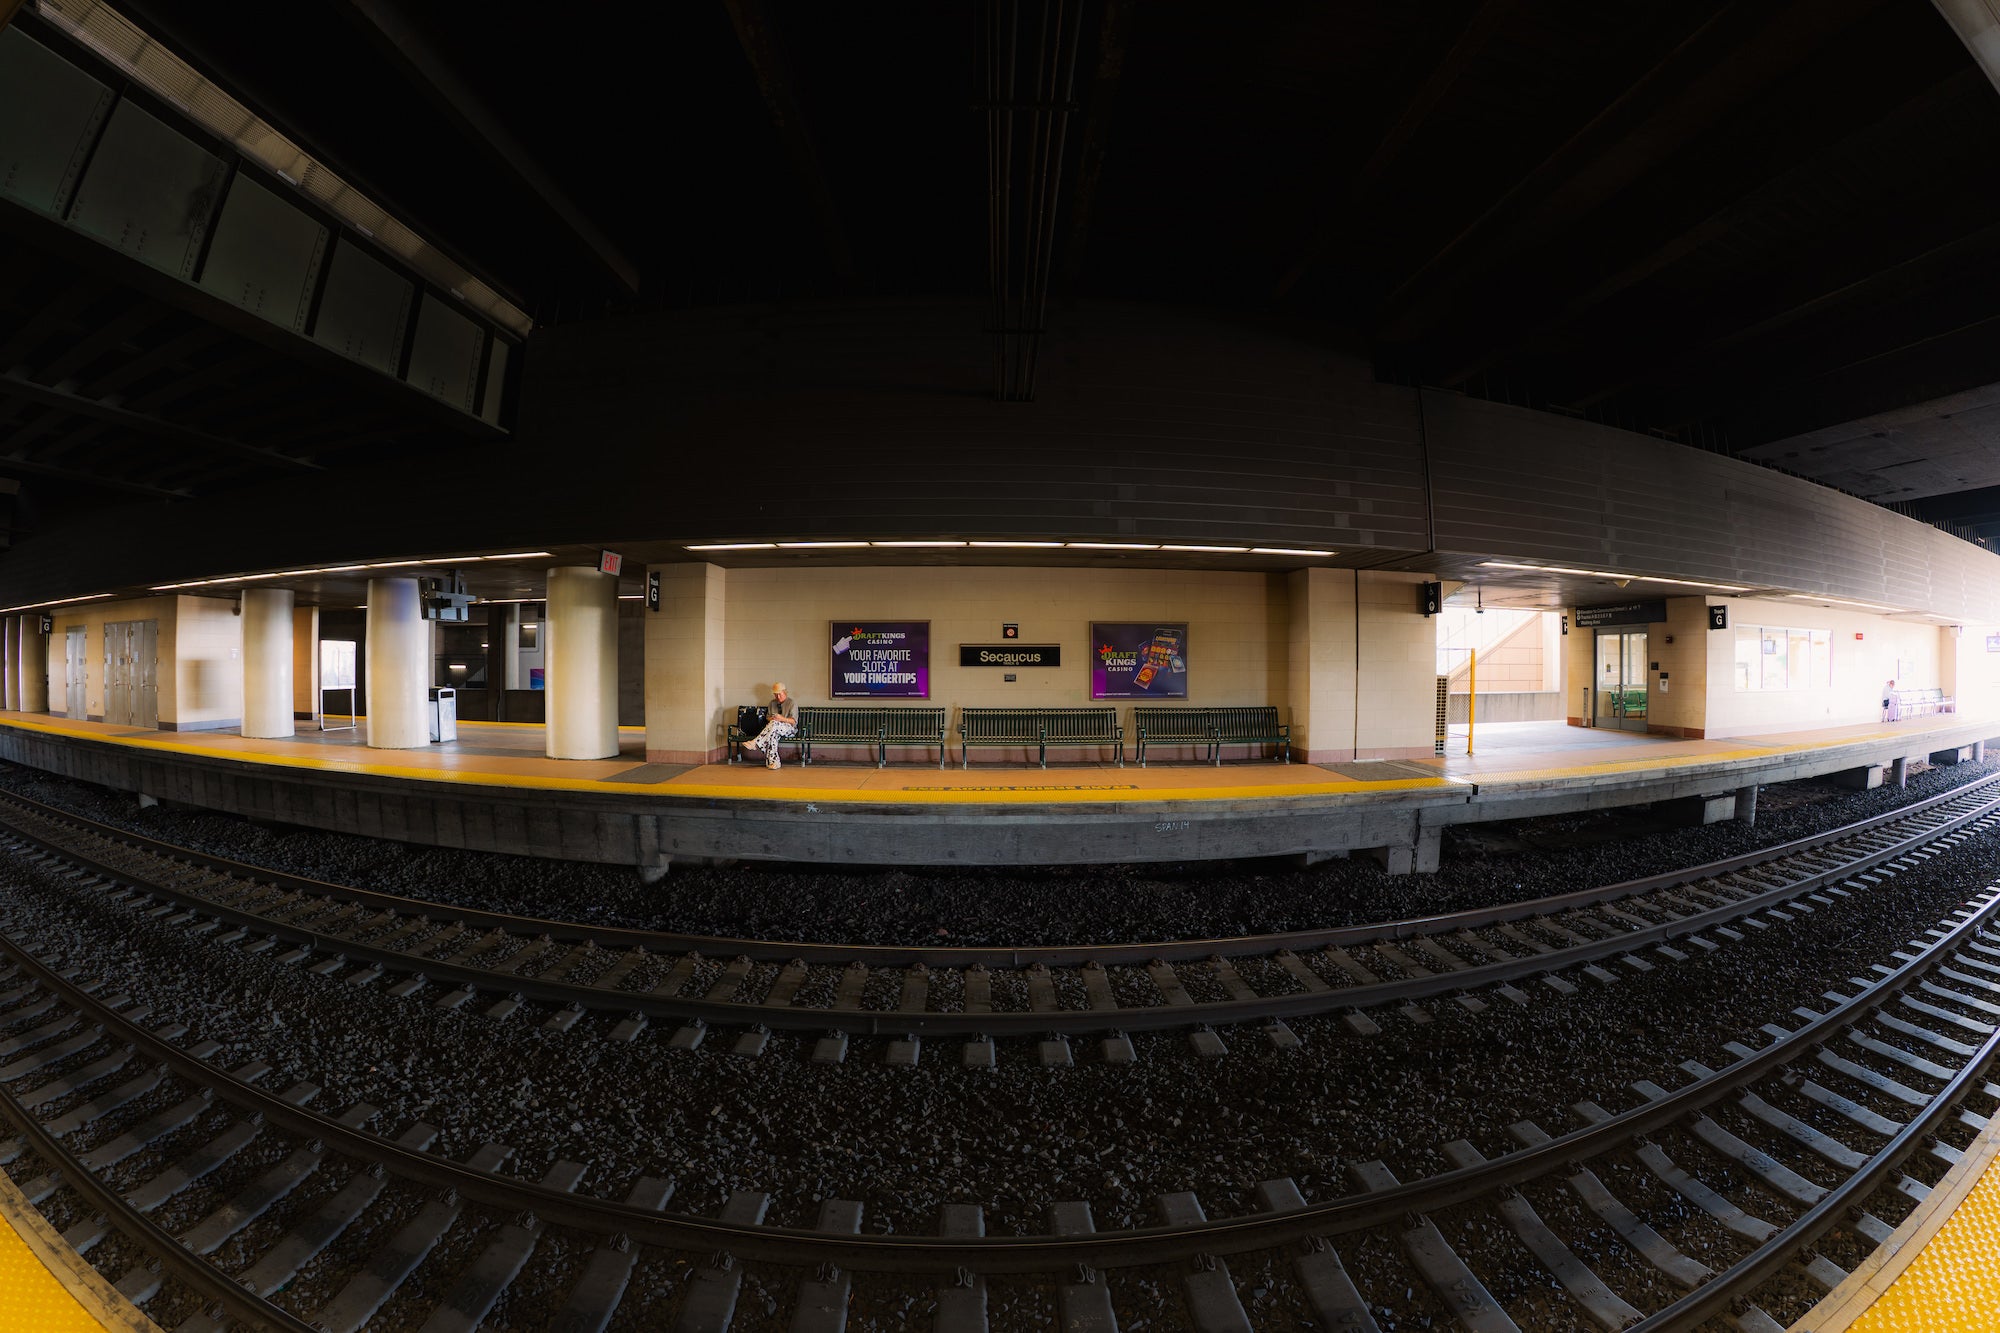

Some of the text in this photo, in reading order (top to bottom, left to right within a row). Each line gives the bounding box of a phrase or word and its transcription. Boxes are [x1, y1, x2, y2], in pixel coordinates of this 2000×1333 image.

[603, 553, 619, 573] EXIT
[651, 587, 658, 601] G
[1716, 615, 1723, 625] G
[853, 632, 906, 640] DRAFTKINGS
[849, 649, 911, 661] YOUR FAVORITE
[980, 650, 1041, 662] Secaucus
[1101, 651, 1138, 660] DRAFT
[862, 661, 899, 672] SLOTS AT
[1105, 658, 1137, 666] KINGS
[844, 672, 917, 684] YOUR FINGERTIPS
